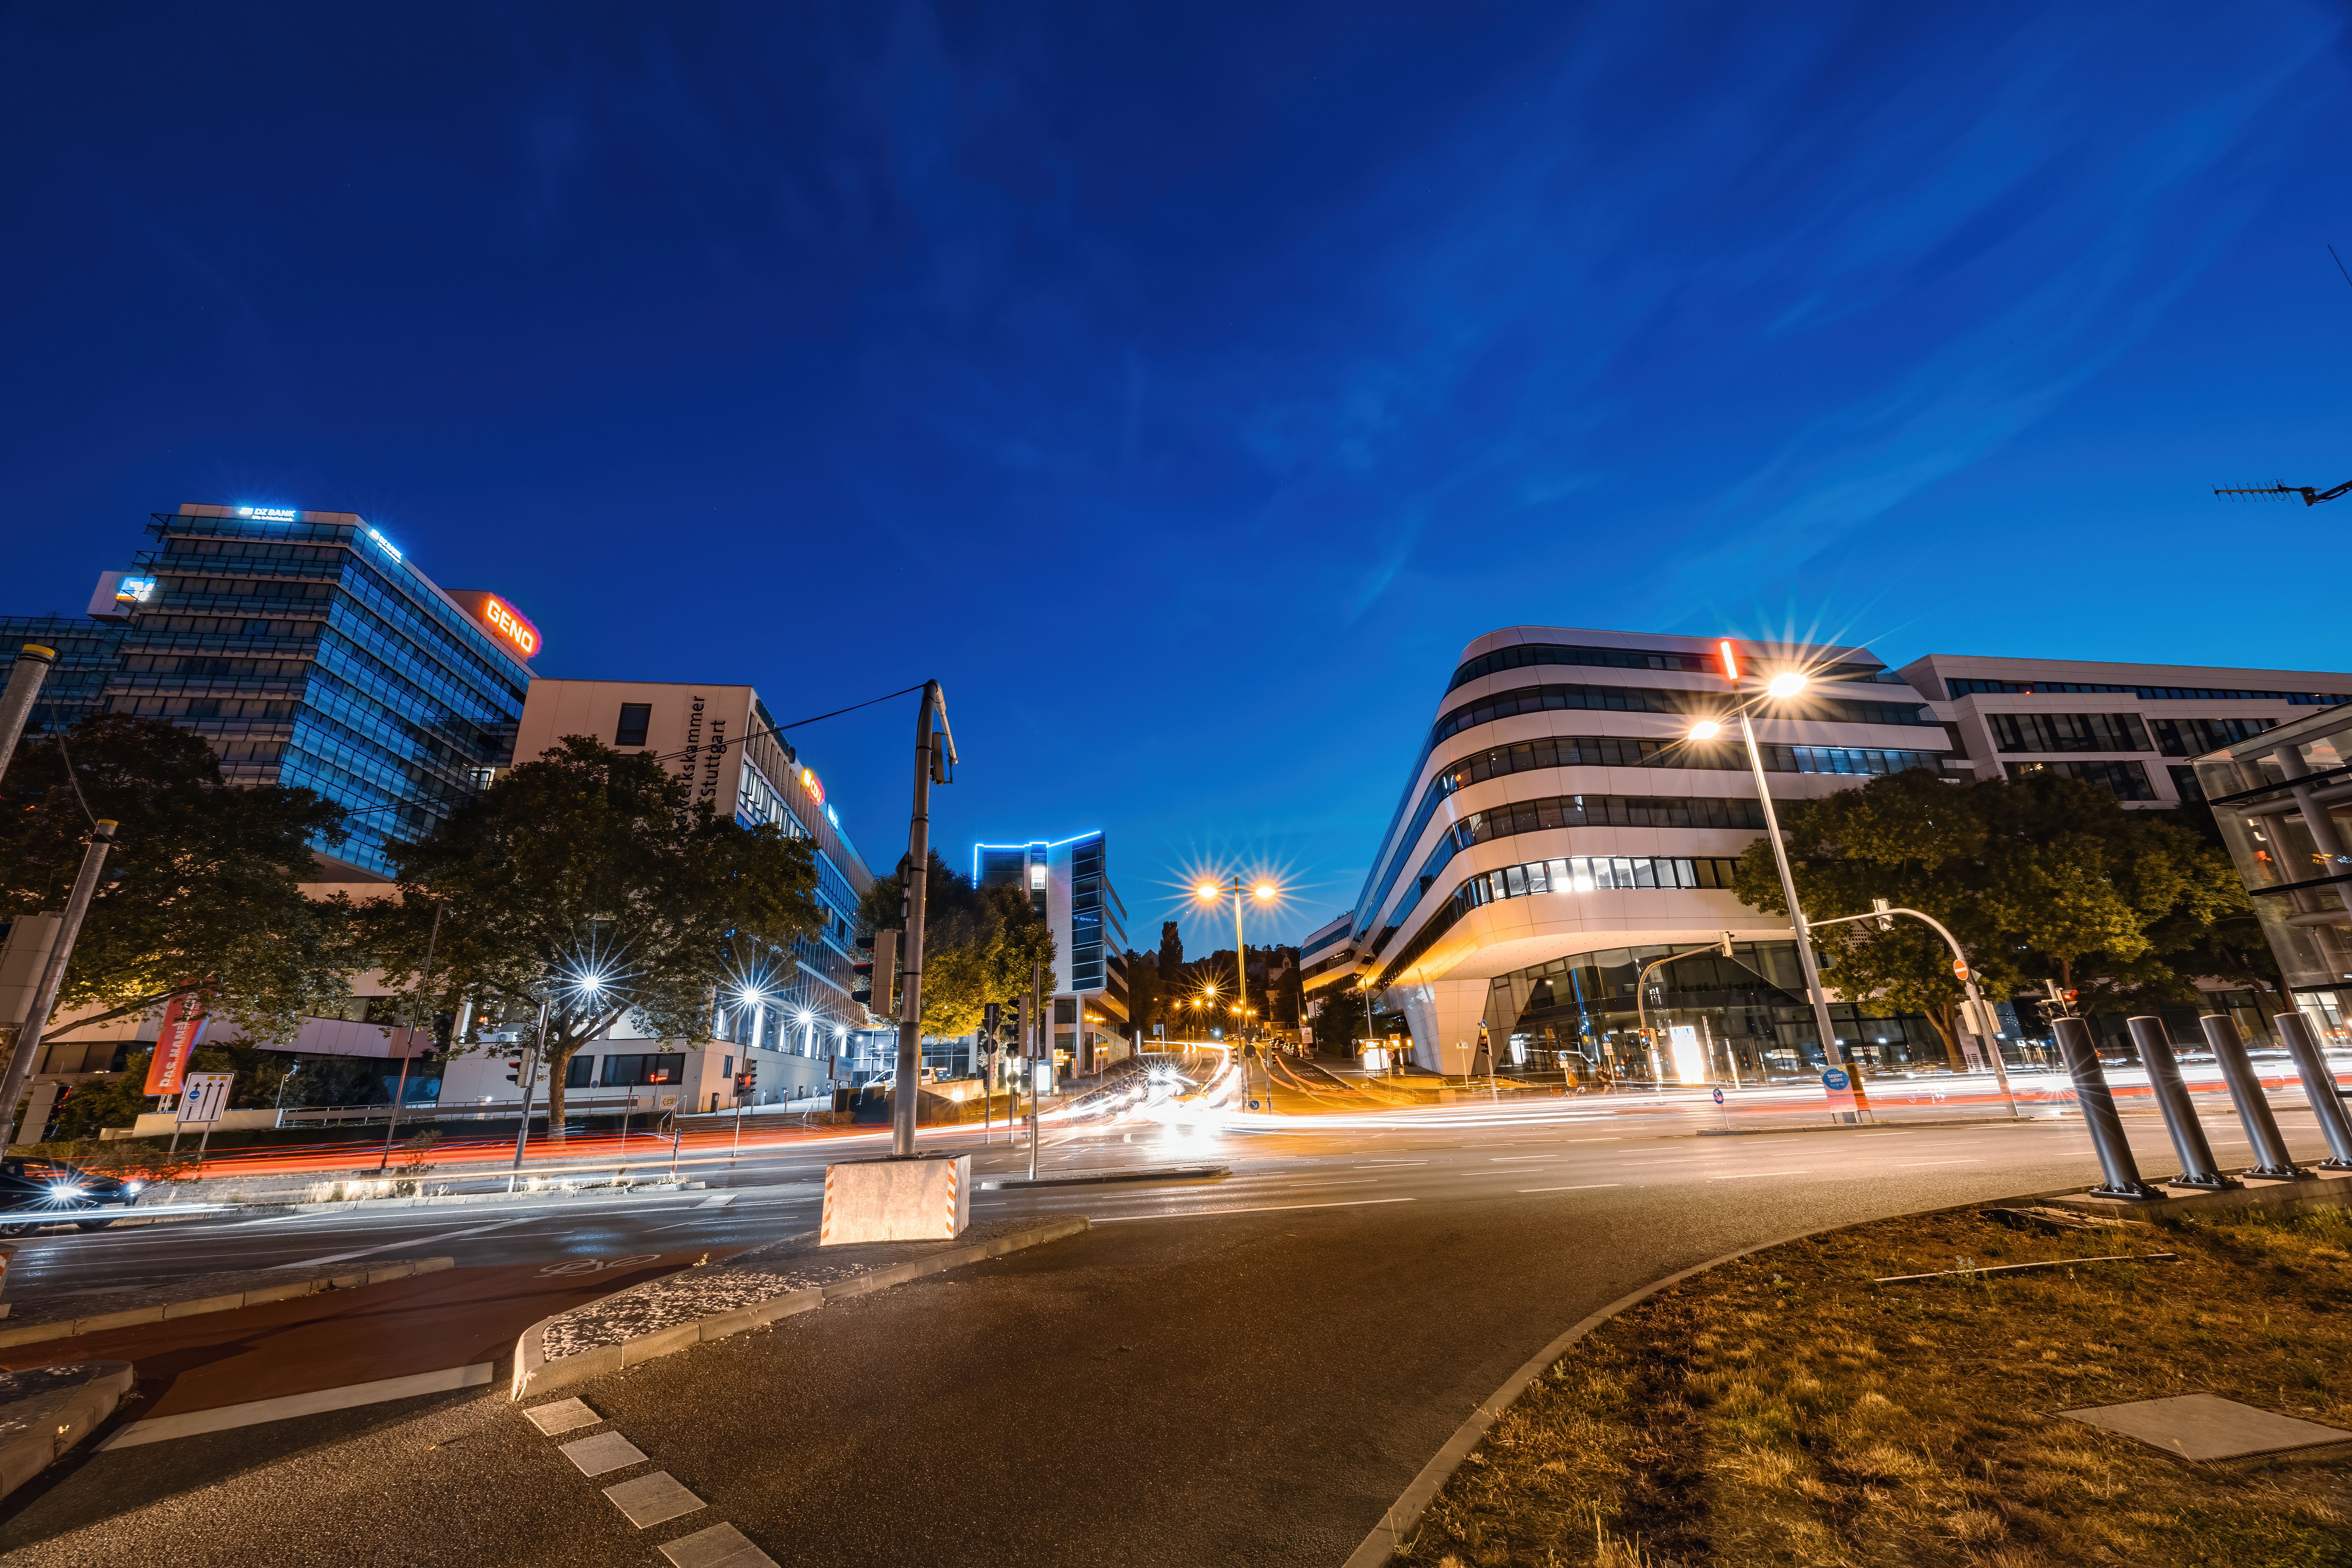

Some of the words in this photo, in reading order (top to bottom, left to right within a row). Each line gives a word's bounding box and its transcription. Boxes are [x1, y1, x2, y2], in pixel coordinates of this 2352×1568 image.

[267, 509, 296, 517] BANK
[487, 600, 533, 652] GENO
[701, 720, 728, 797] Stuttgart
[810, 780, 822, 803] CDU
[159, 1062, 176, 1087] DAS
